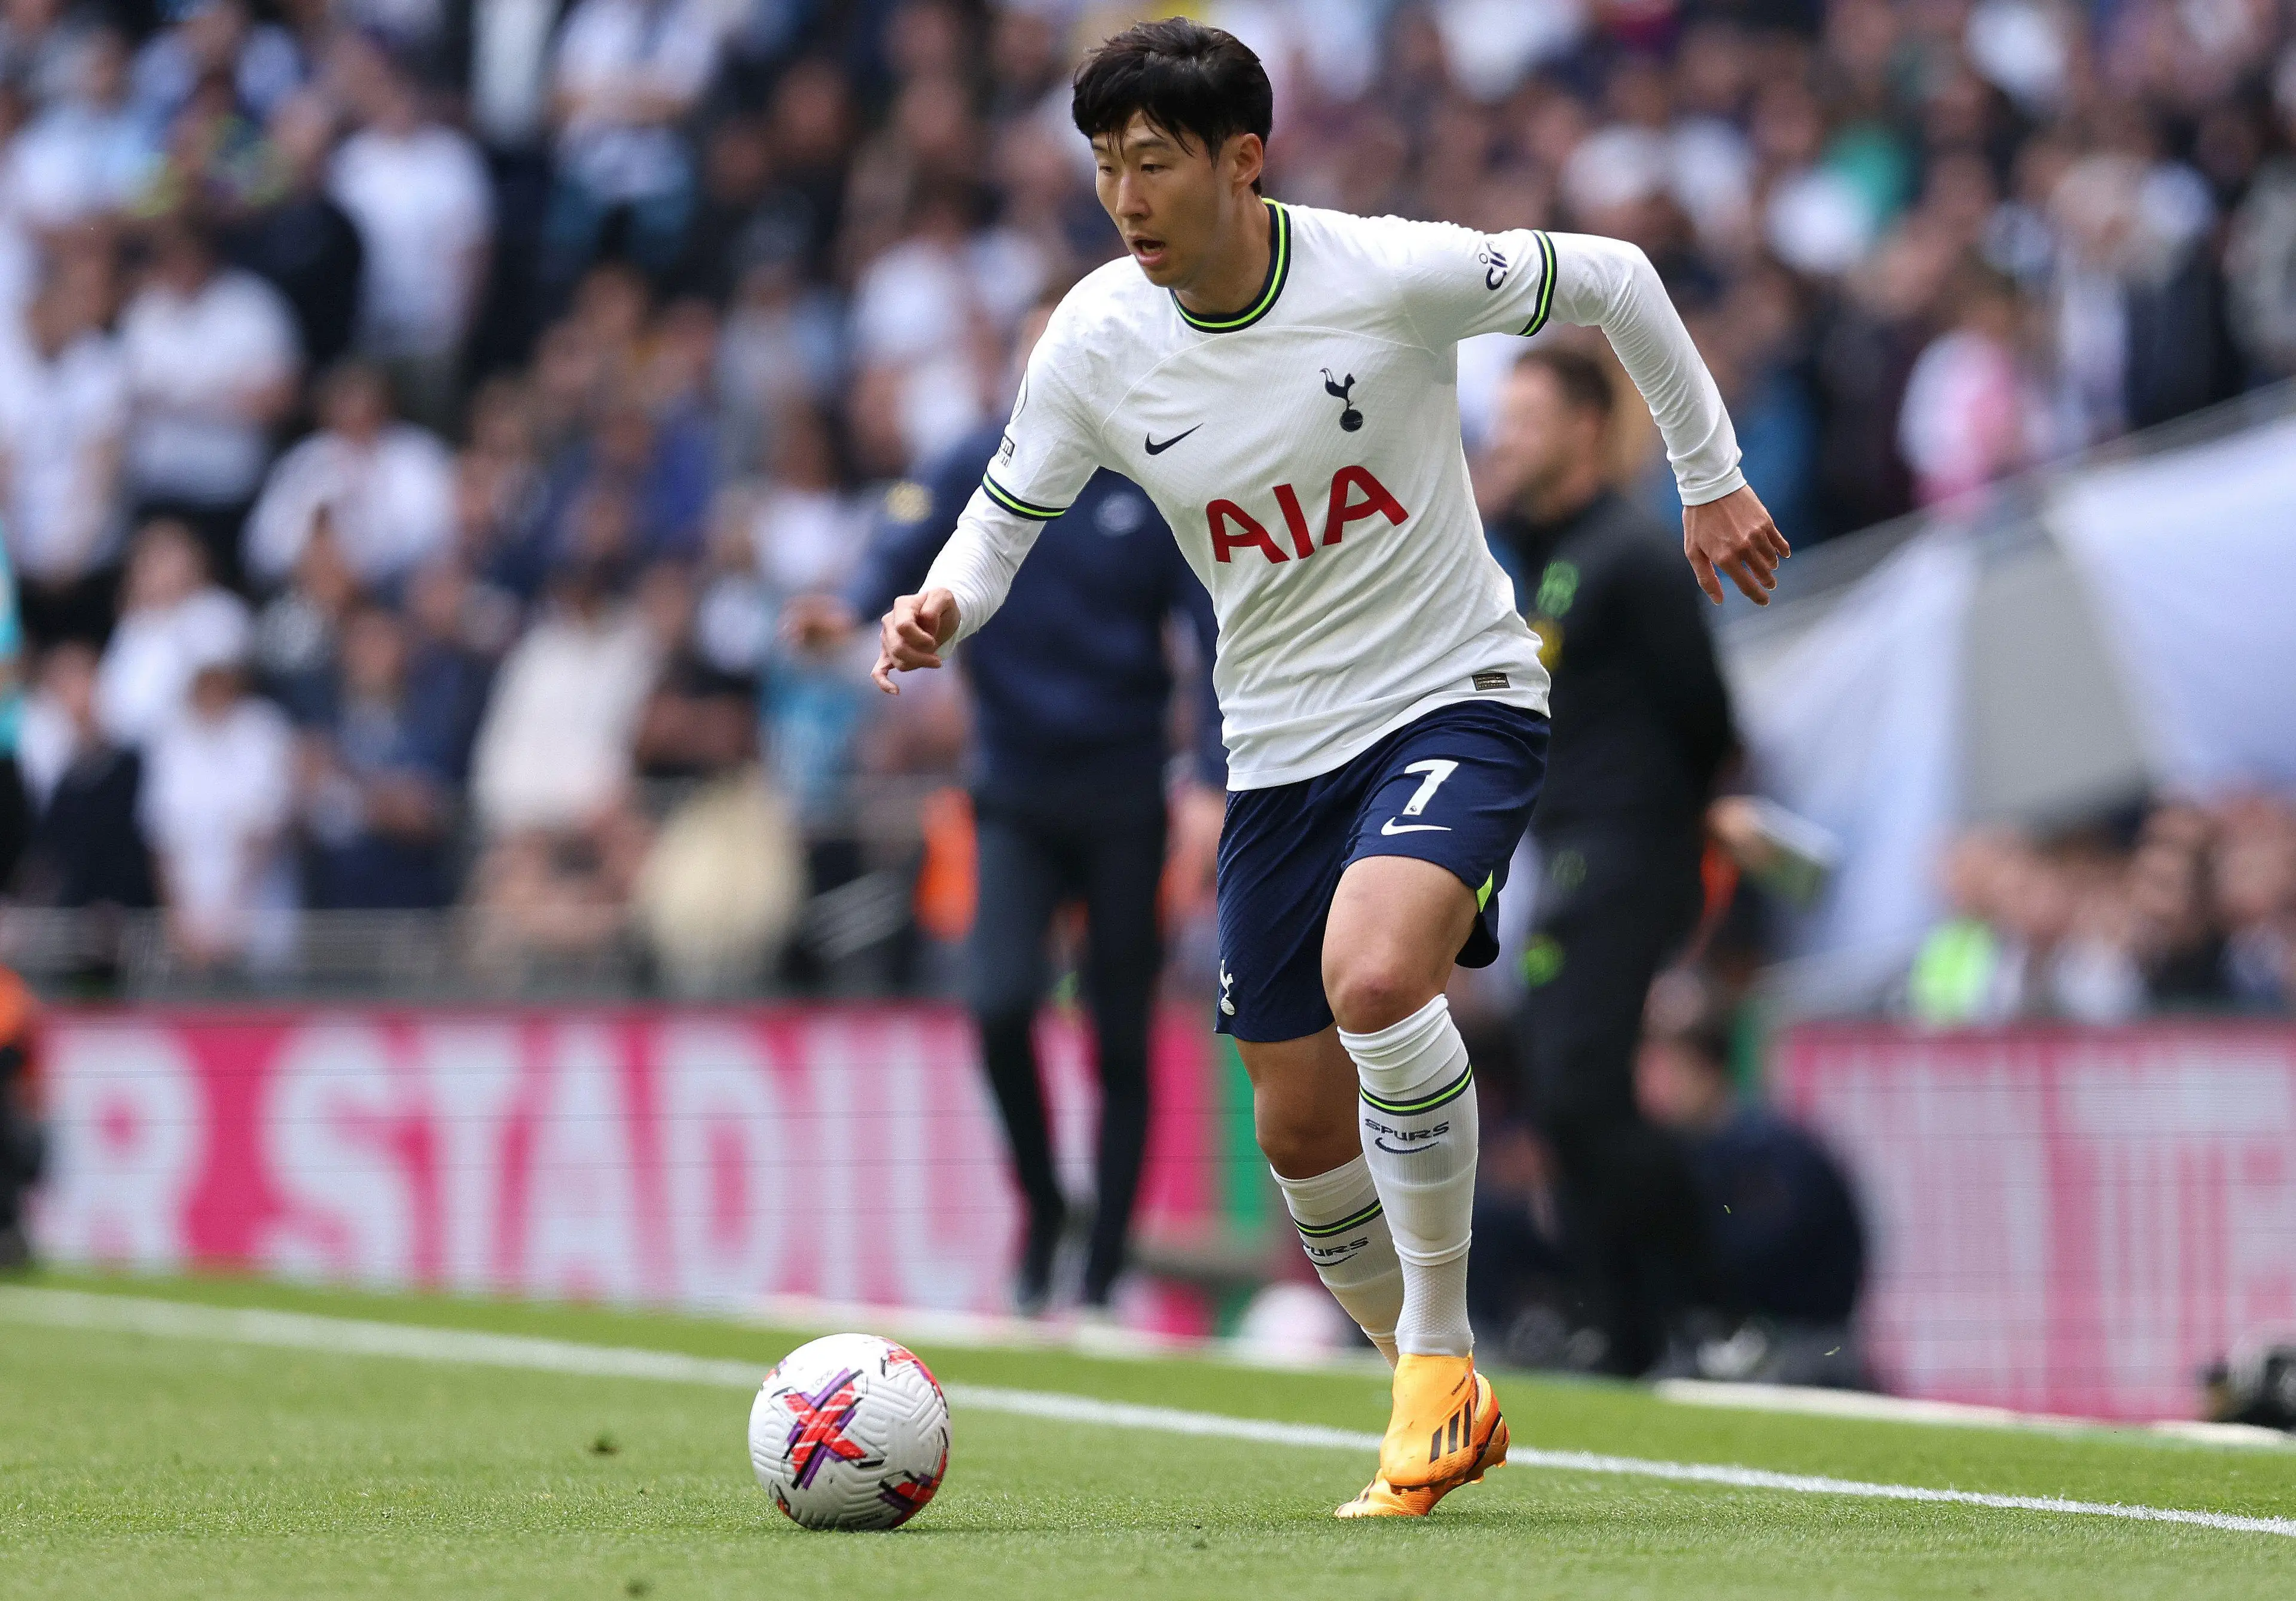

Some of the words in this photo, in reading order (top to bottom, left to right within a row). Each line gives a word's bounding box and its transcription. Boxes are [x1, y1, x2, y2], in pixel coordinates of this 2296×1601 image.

[1205, 465, 1409, 564] AIA
[1402, 759, 1459, 816] 7
[1365, 1118, 1449, 1141] SPURS
